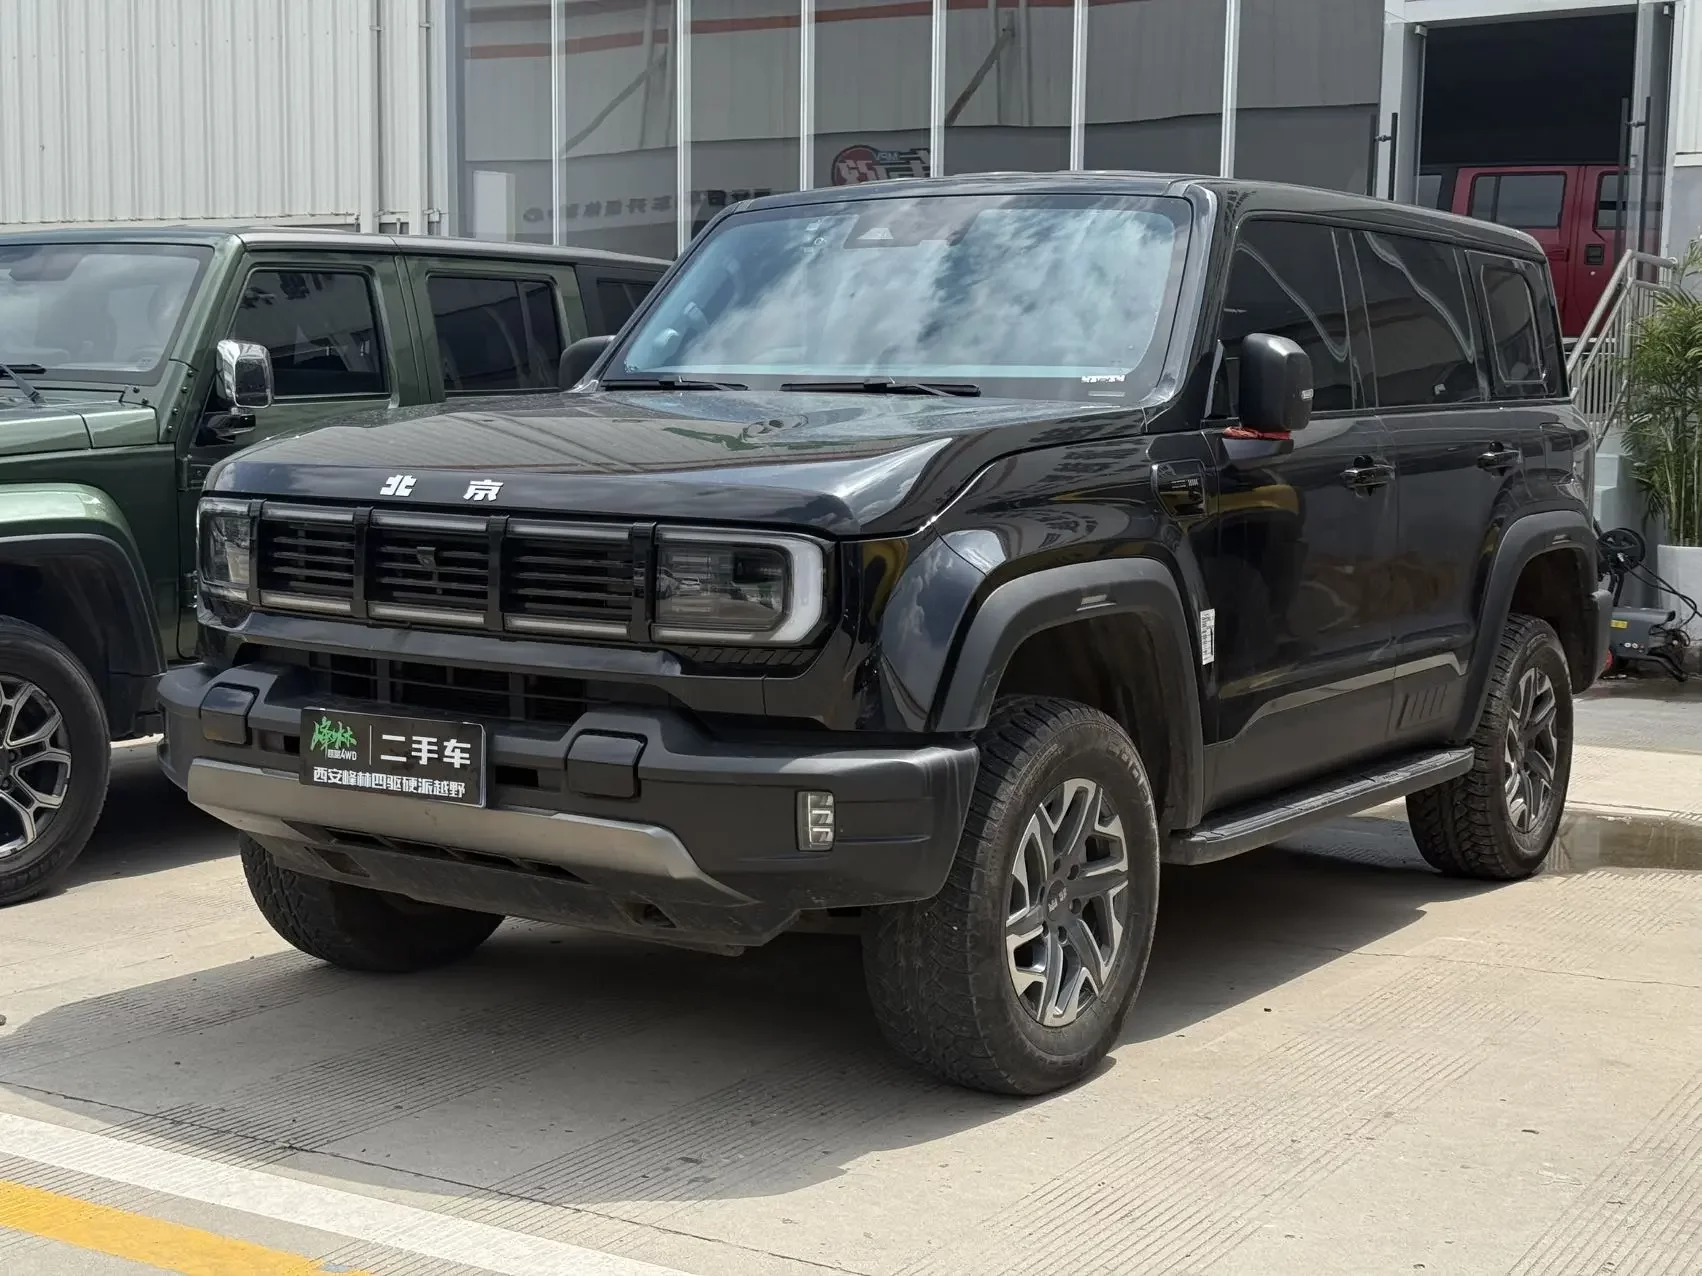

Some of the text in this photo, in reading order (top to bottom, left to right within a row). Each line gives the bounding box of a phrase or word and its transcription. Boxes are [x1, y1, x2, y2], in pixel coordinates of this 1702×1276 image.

[379, 474, 504, 502] 北京
[380, 733, 471, 769] 二手车
[313, 766, 466, 799] 西安峰林四驱硬派越野
